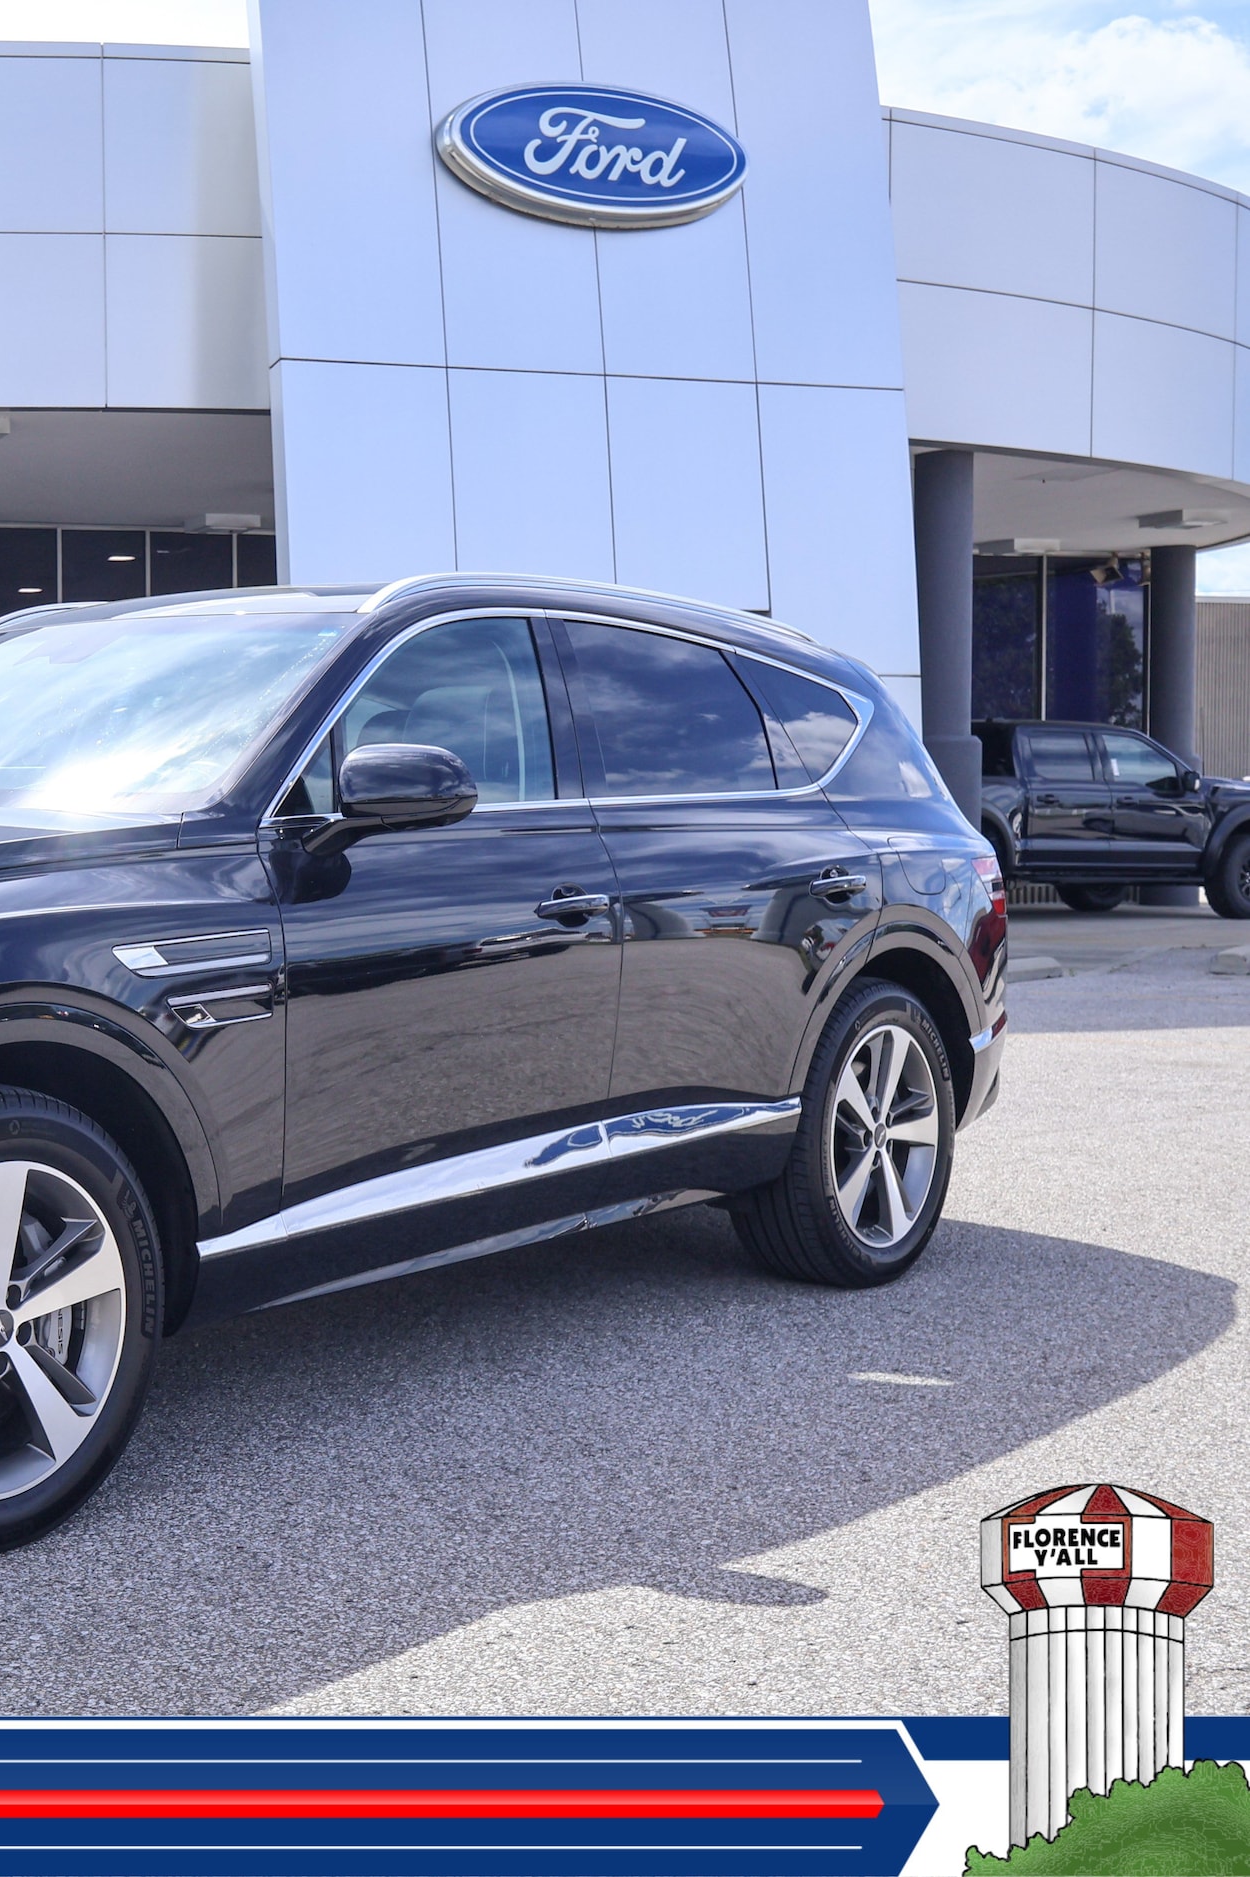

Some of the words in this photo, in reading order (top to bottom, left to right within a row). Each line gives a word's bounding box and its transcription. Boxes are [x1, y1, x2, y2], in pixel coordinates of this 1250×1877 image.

[524, 106, 687, 187] Ford
[921, 1019, 950, 1078] MICHELIN
[132, 1218, 156, 1335] MICHELIN
